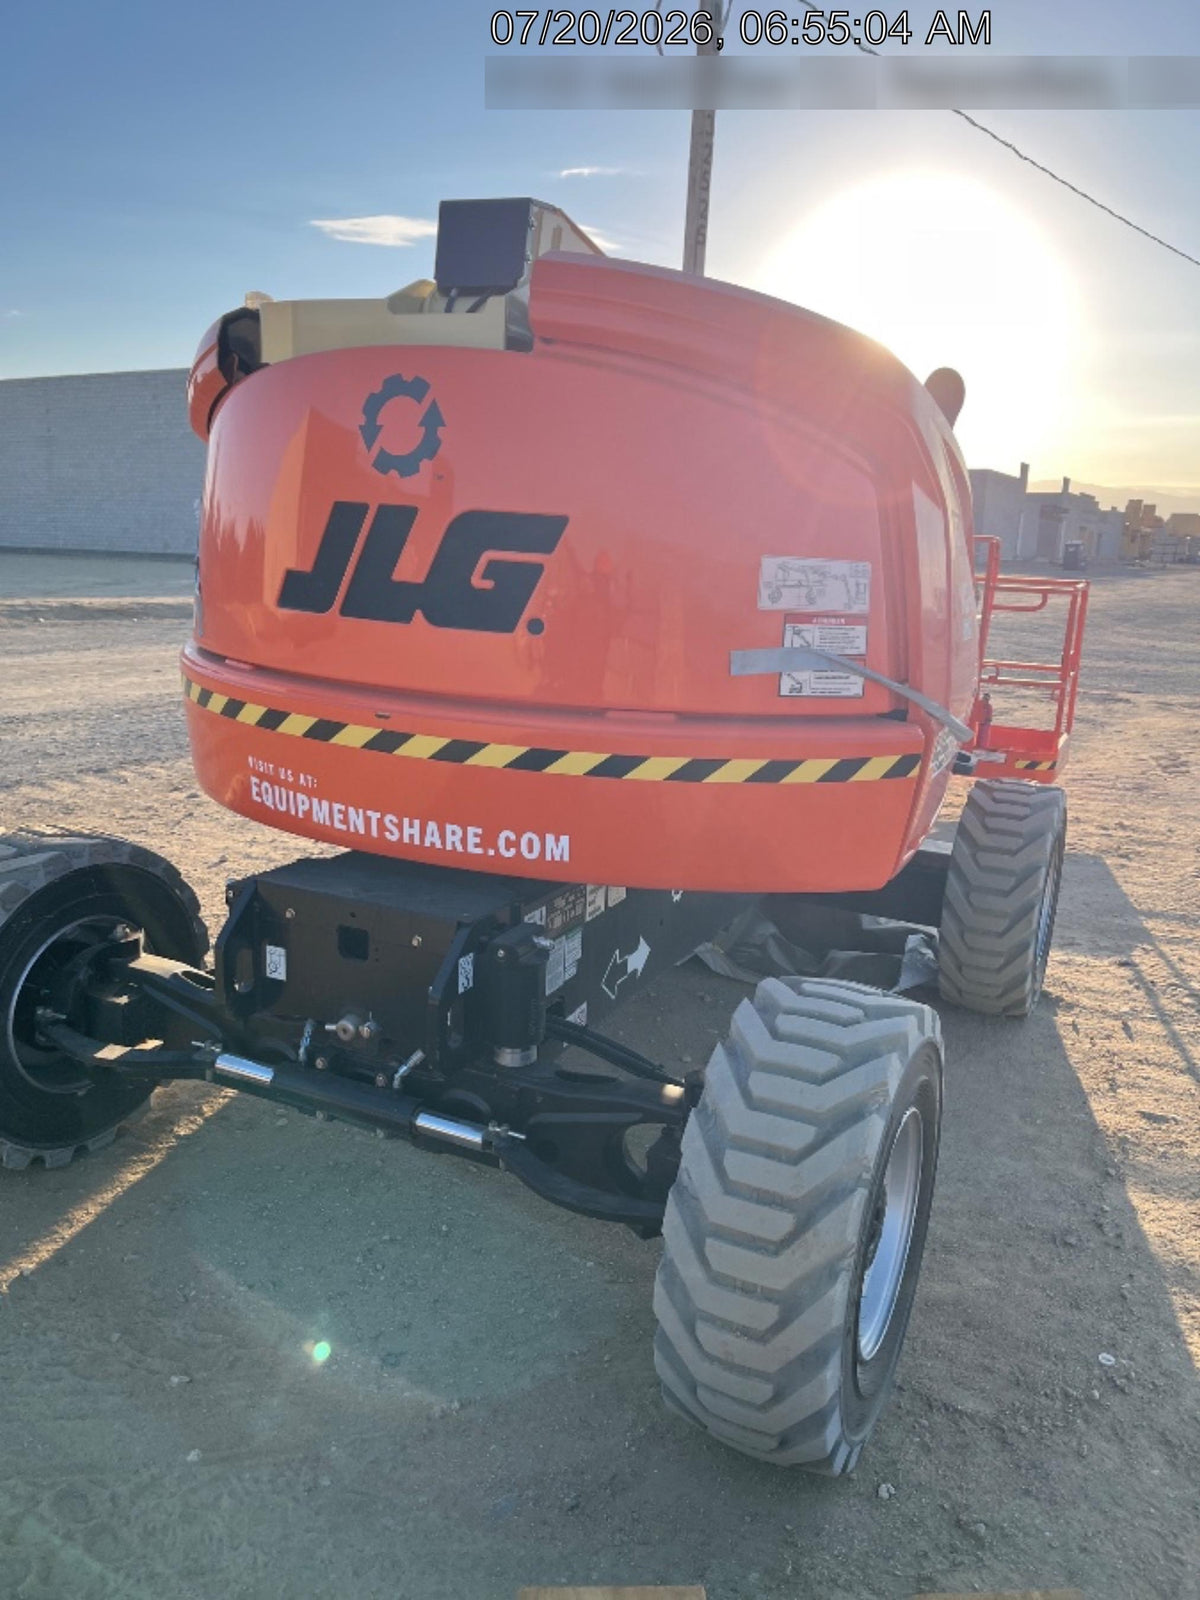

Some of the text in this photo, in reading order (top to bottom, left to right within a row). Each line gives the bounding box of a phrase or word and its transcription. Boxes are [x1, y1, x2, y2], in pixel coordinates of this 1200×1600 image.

[248, 755, 318, 788] VISIT US AT:
[249, 776, 571, 862] EQUIPMENTSHARE.COM
